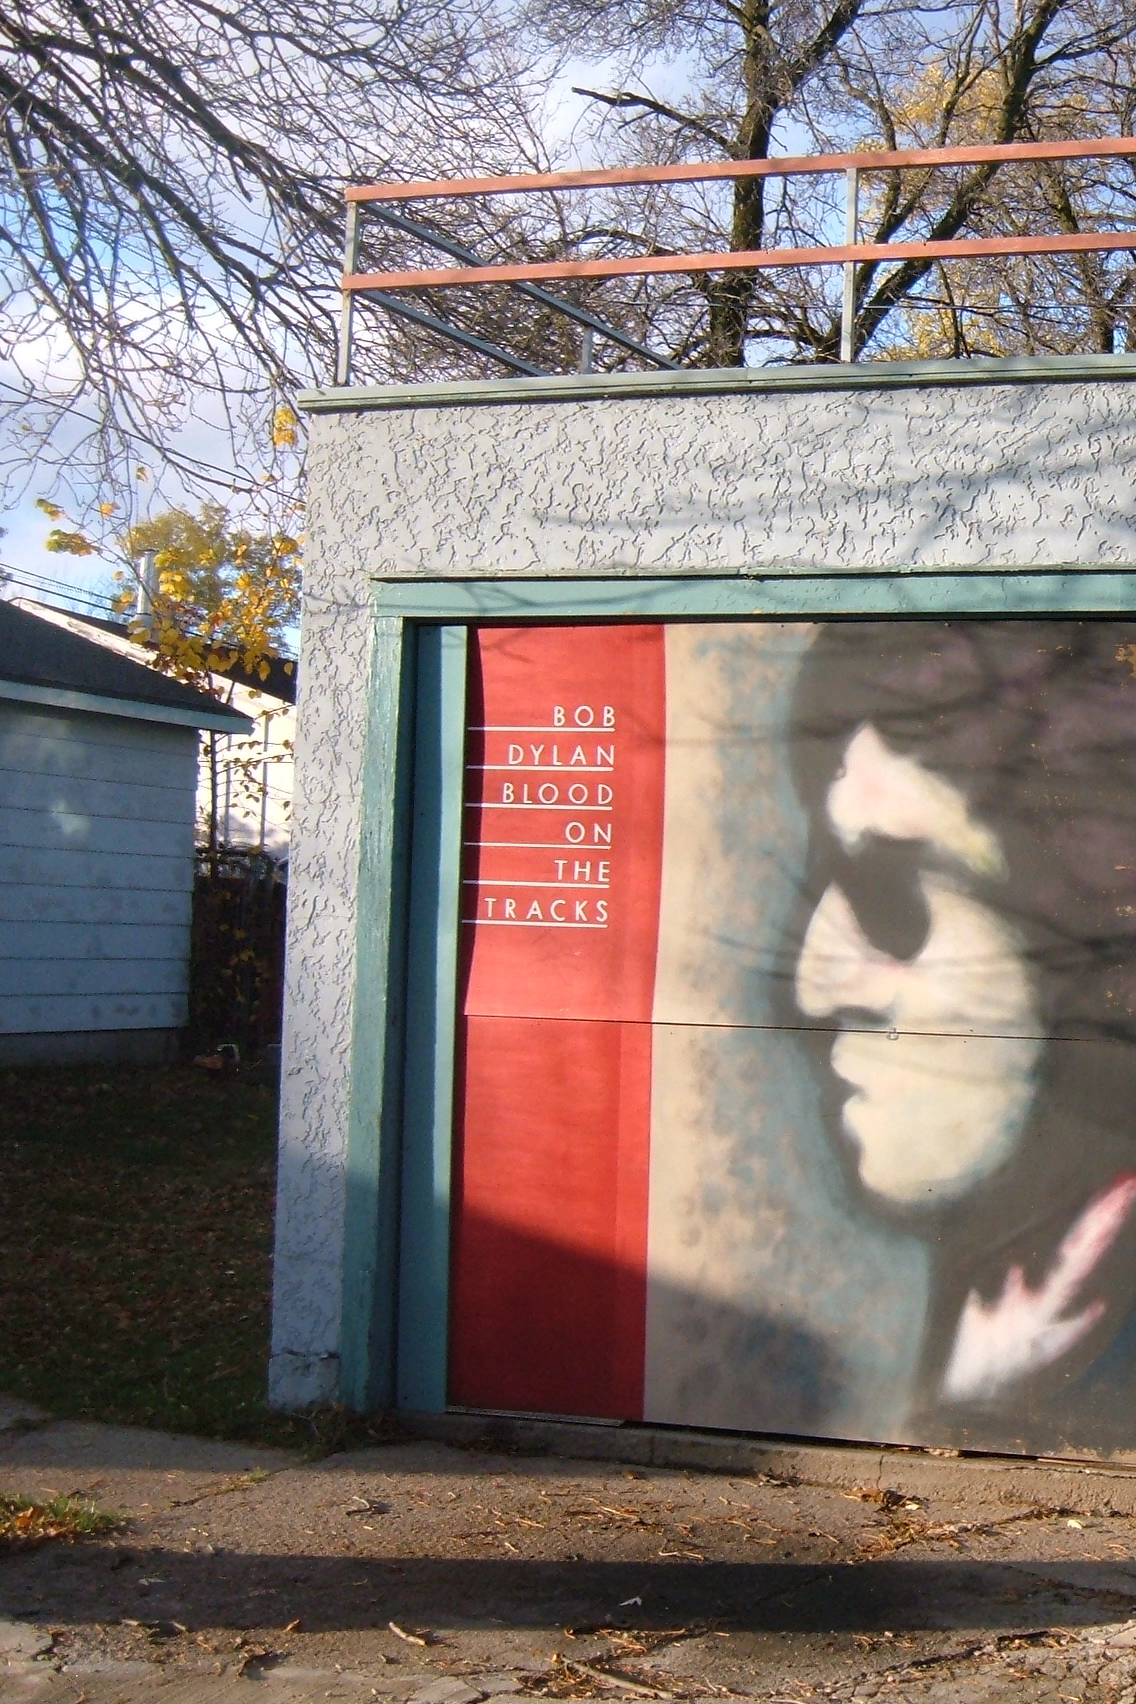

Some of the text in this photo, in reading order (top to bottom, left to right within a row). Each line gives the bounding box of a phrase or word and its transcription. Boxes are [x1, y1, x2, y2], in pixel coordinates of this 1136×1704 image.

[553, 705, 615, 727] BOB
[508, 744, 615, 766] DYLAN
[502, 783, 613, 805] BLOOD
[565, 821, 612, 843] ON
[554, 859, 611, 882] THE
[484, 898, 609, 922] TRACKS
